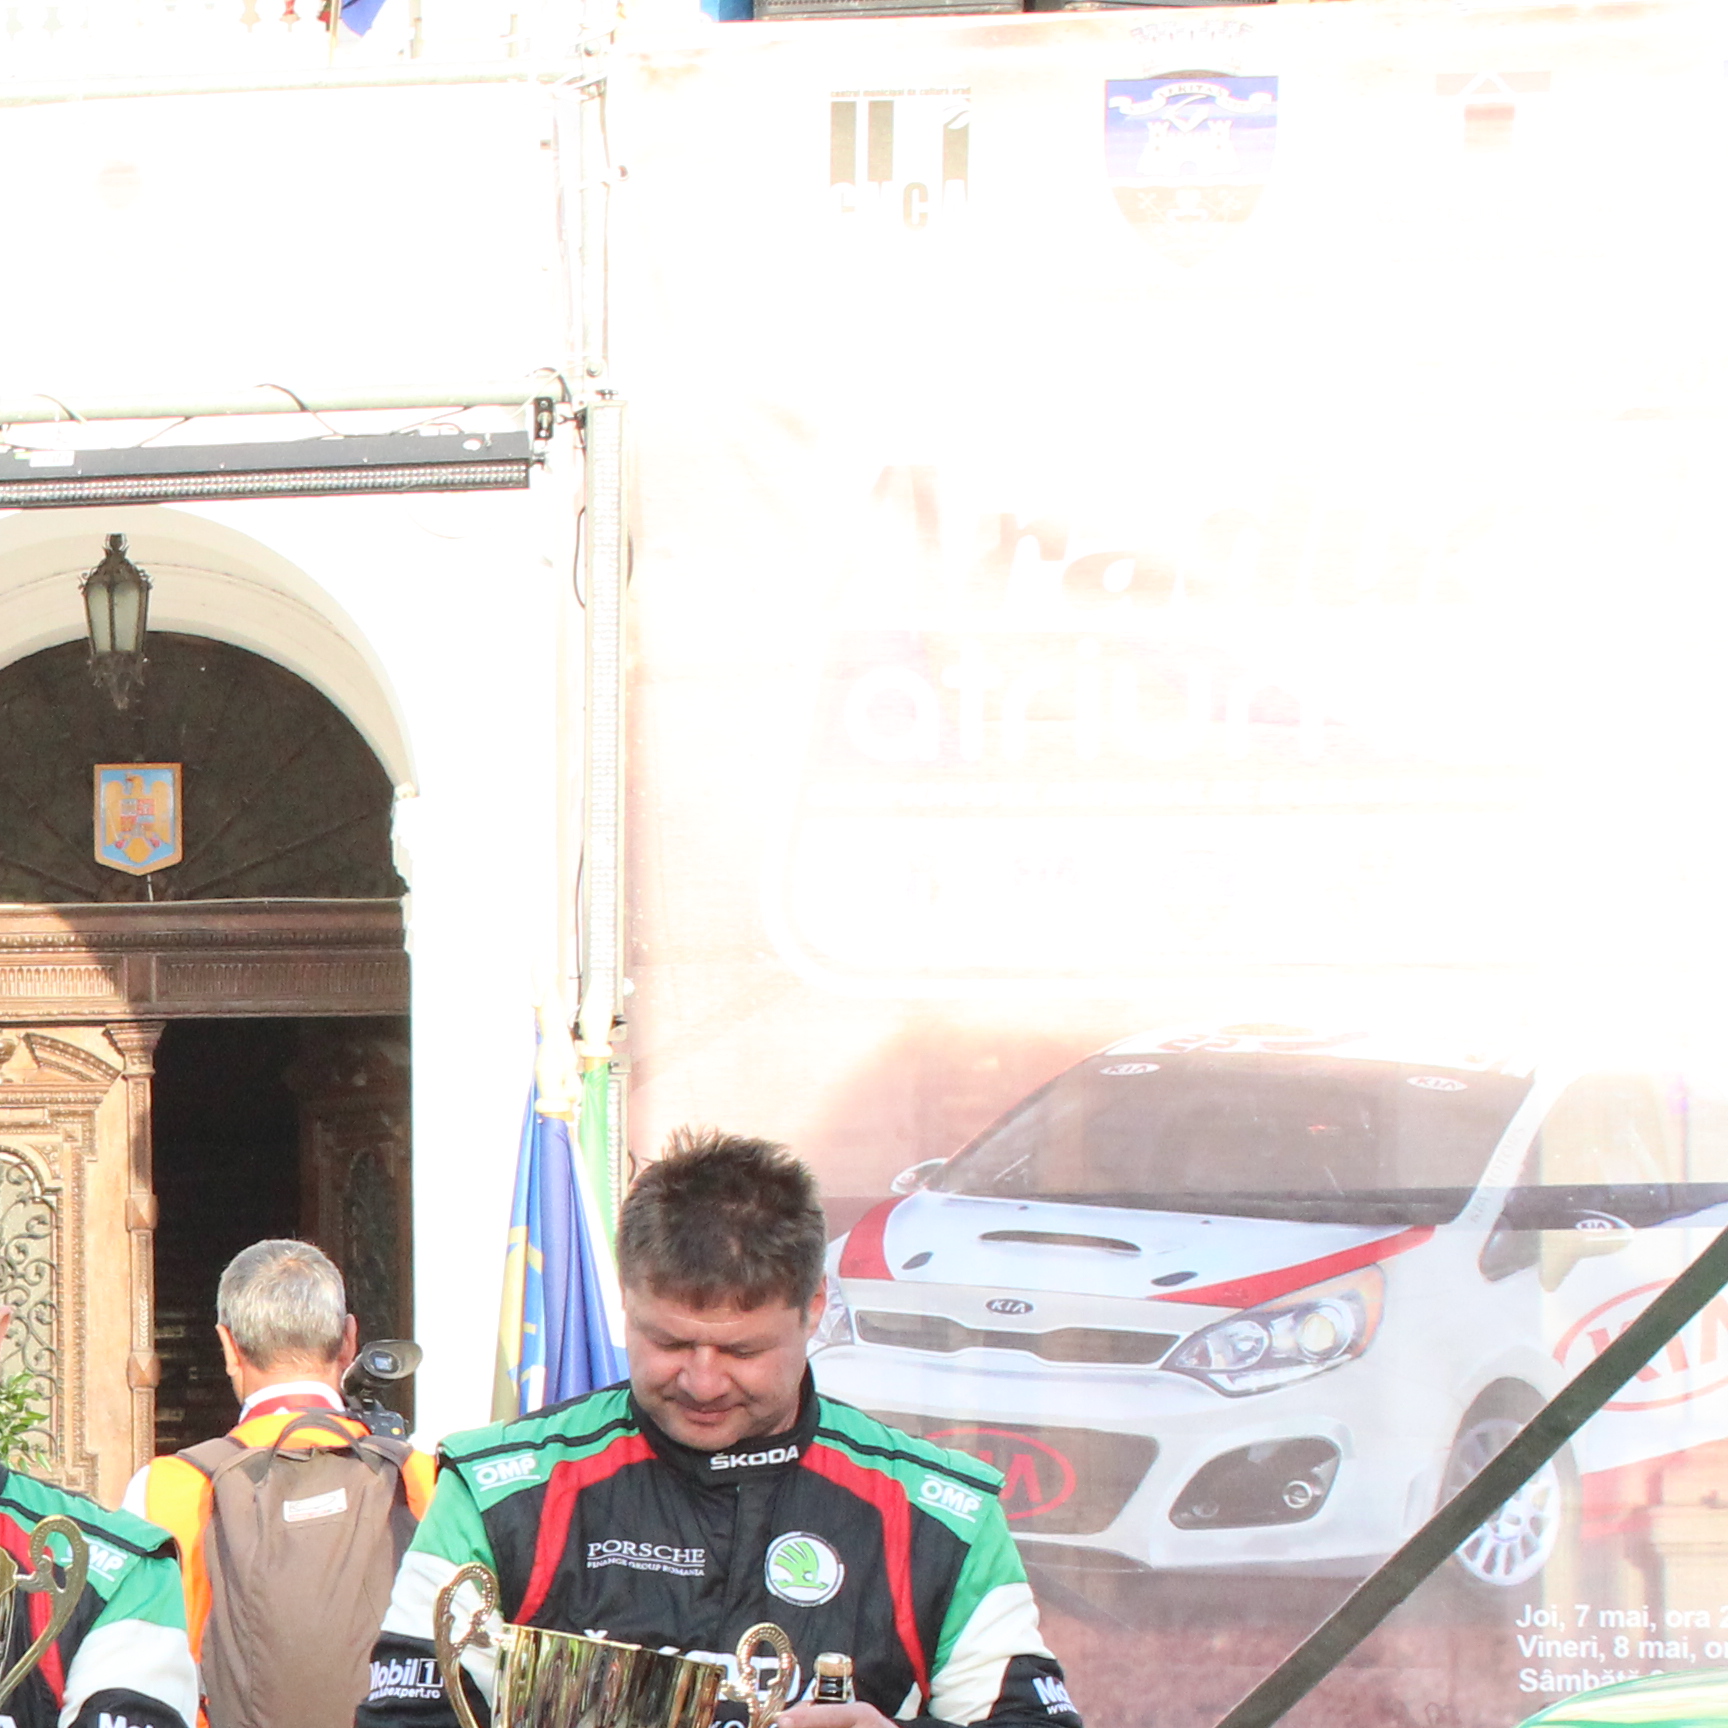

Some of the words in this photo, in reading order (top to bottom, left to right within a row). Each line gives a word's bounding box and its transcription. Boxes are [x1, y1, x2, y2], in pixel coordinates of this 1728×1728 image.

[1109, 1063, 1150, 1075] KIA
[1415, 1077, 1453, 1090] KIA
[991, 1299, 1029, 1315] KIA
[710, 1444, 799, 1471] ŠKODA
[475, 1454, 537, 1492] OMP
[918, 1475, 982, 1517] OMP
[588, 1539, 705, 1565] PORSCHE
[587, 1558, 626, 1569] FINANCE
[663, 1565, 705, 1577] ROMANIA
[1516, 1604, 1566, 1632] Joi,
[1574, 1604, 1591, 1628] 7
[1599, 1605, 1657, 1632] mai,
[1665, 1608, 1710, 1628] ora
[1517, 1635, 1606, 1662] Vineri,
[1613, 1636, 1630, 1658] 8
[1638, 1636, 1696, 1663] mai,
